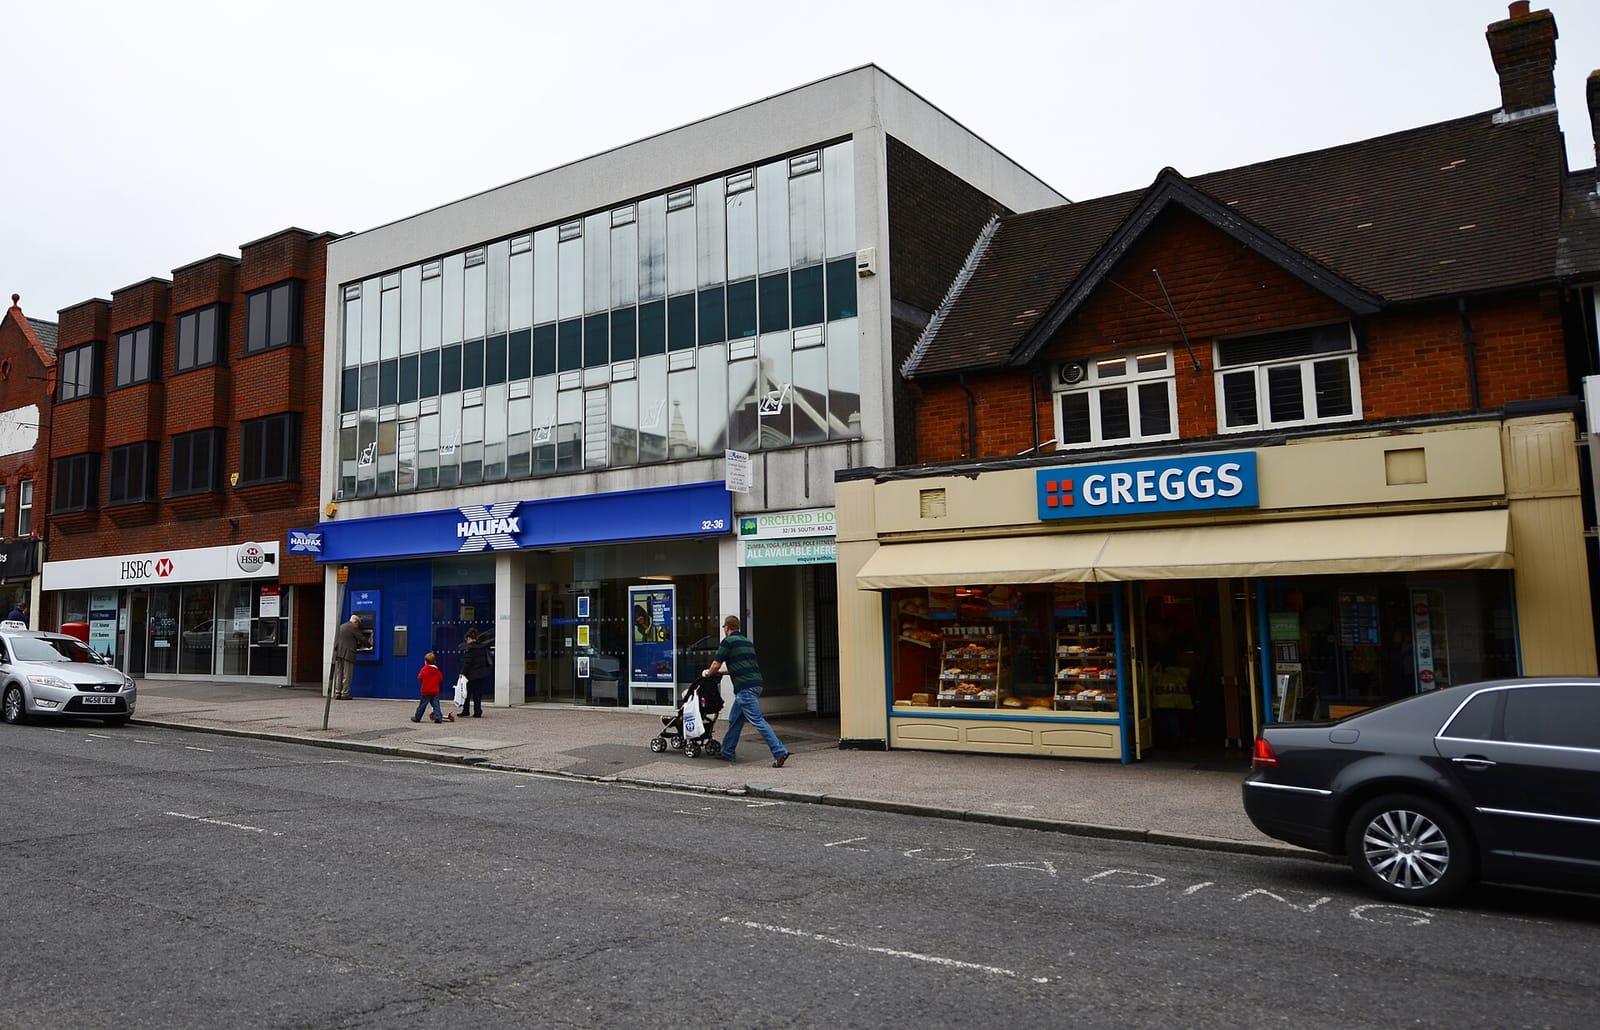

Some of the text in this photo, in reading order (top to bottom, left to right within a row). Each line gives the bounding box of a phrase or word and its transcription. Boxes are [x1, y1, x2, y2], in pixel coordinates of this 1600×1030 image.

[1082, 463, 1243, 506] GREGGS
[701, 520, 723, 530] 32-36
[759, 511, 837, 526] ORCHARD HO
[747, 545, 837, 559] ALL AVAILABLE HERE
[241, 555, 264, 565] HSBC
[121, 559, 153, 579] HSBC
[825, 836, 1435, 927] LOADING
